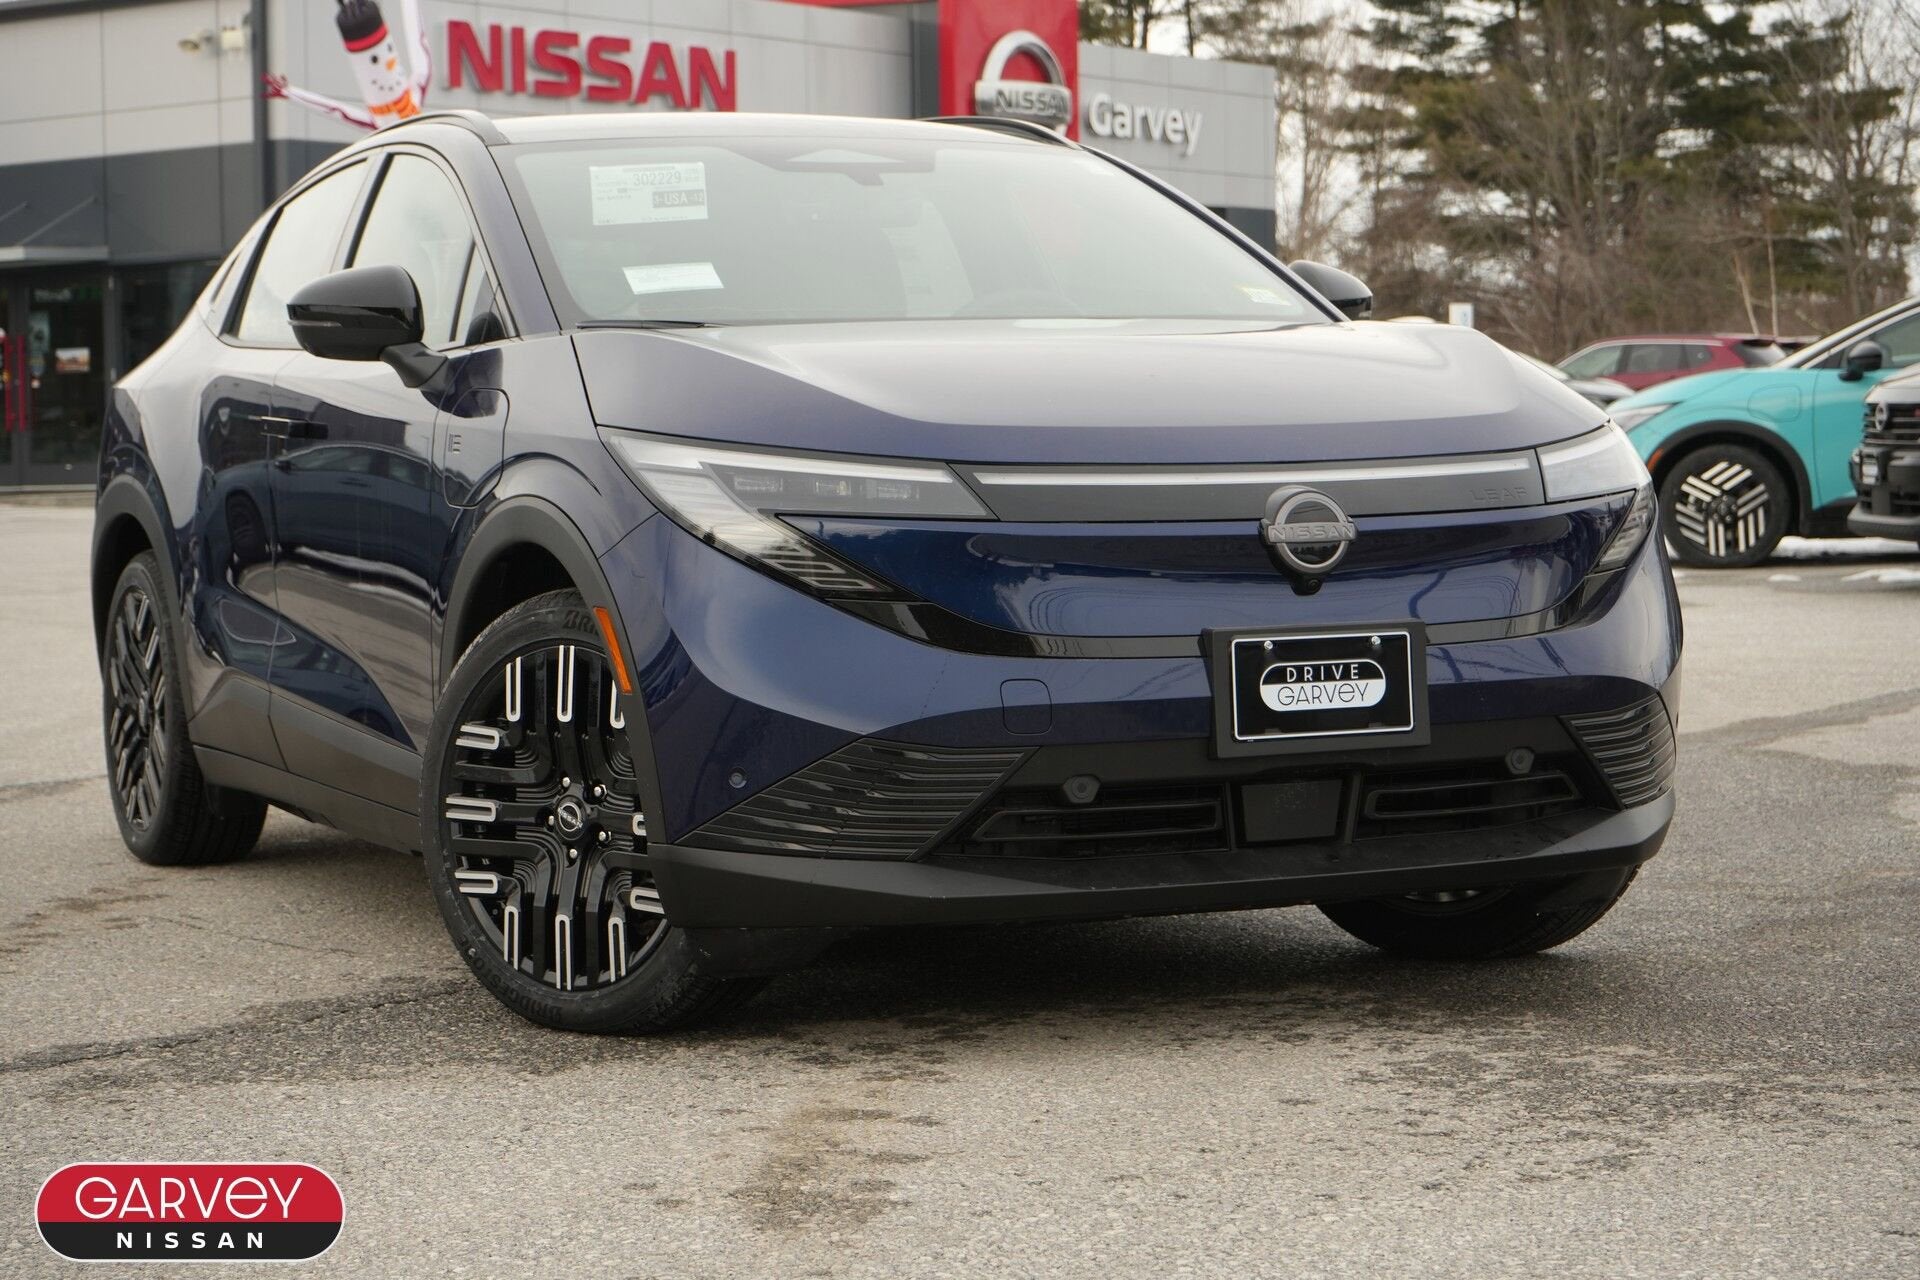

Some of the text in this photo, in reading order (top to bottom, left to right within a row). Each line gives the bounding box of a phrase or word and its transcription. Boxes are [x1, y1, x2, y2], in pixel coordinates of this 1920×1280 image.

[447, 19, 736, 112] NISSAN
[994, 88, 1068, 118] NISSAN
[1088, 91, 1202, 156] Garvey
[632, 171, 682, 187] 302229
[1470, 486, 1528, 502] LEAF
[1271, 525, 1355, 541] NISSAN
[1286, 664, 1359, 683] DRIVE
[456, 934, 562, 1023] BRIDGESTOE
